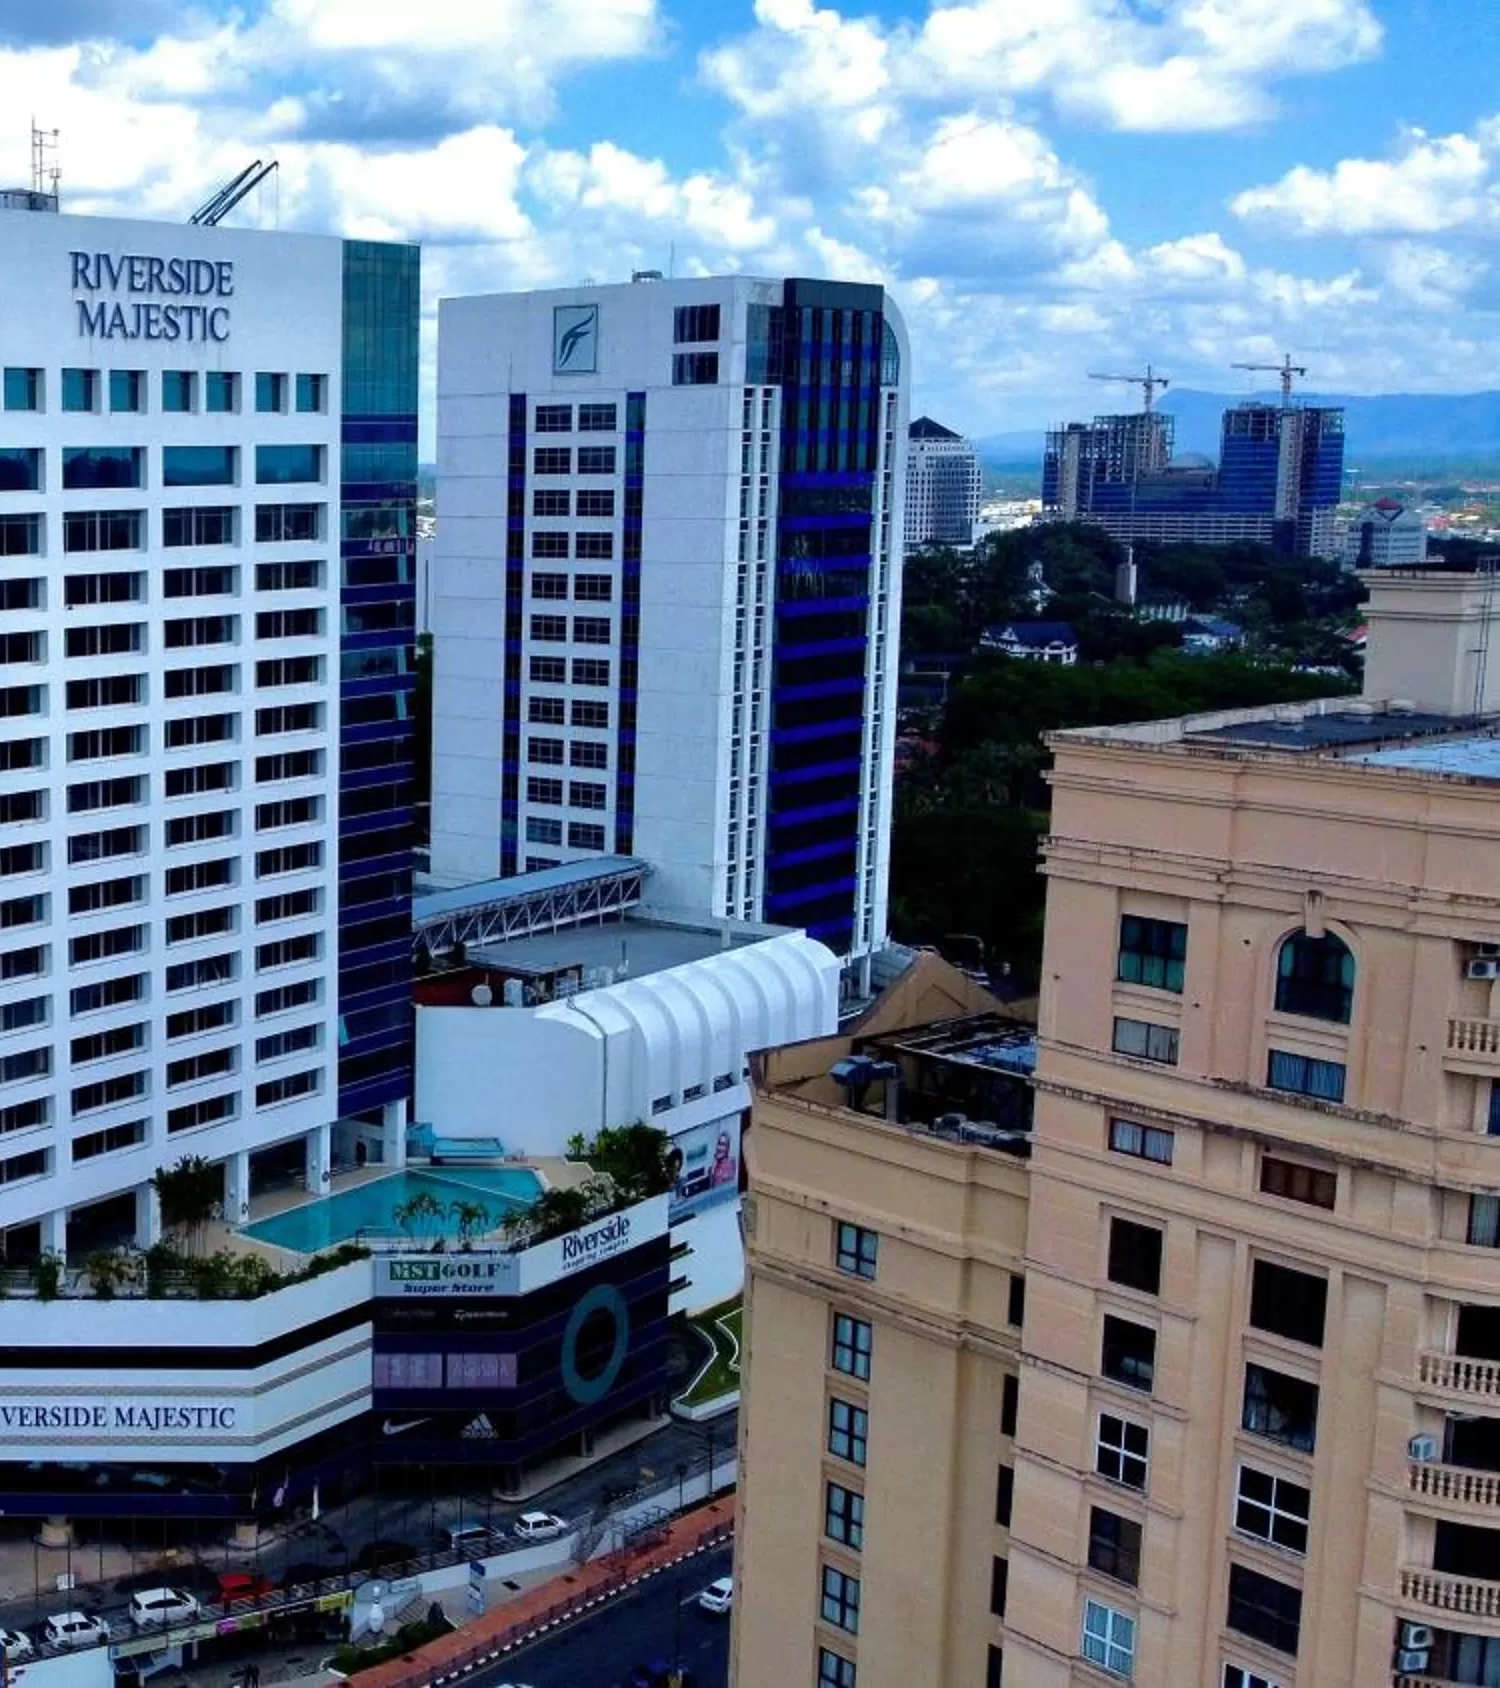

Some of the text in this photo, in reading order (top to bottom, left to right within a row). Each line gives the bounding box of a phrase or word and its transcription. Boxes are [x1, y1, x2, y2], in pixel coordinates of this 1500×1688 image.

[68, 251, 234, 297] RIVERSIDE
[76, 299, 231, 342] MAJESTIC
[562, 1215, 631, 1261] Riverside
[442, 1263, 500, 1278] GOLF
[451, 1283, 495, 1293] Store
[114, 1406, 236, 1430] MAJESTIC
